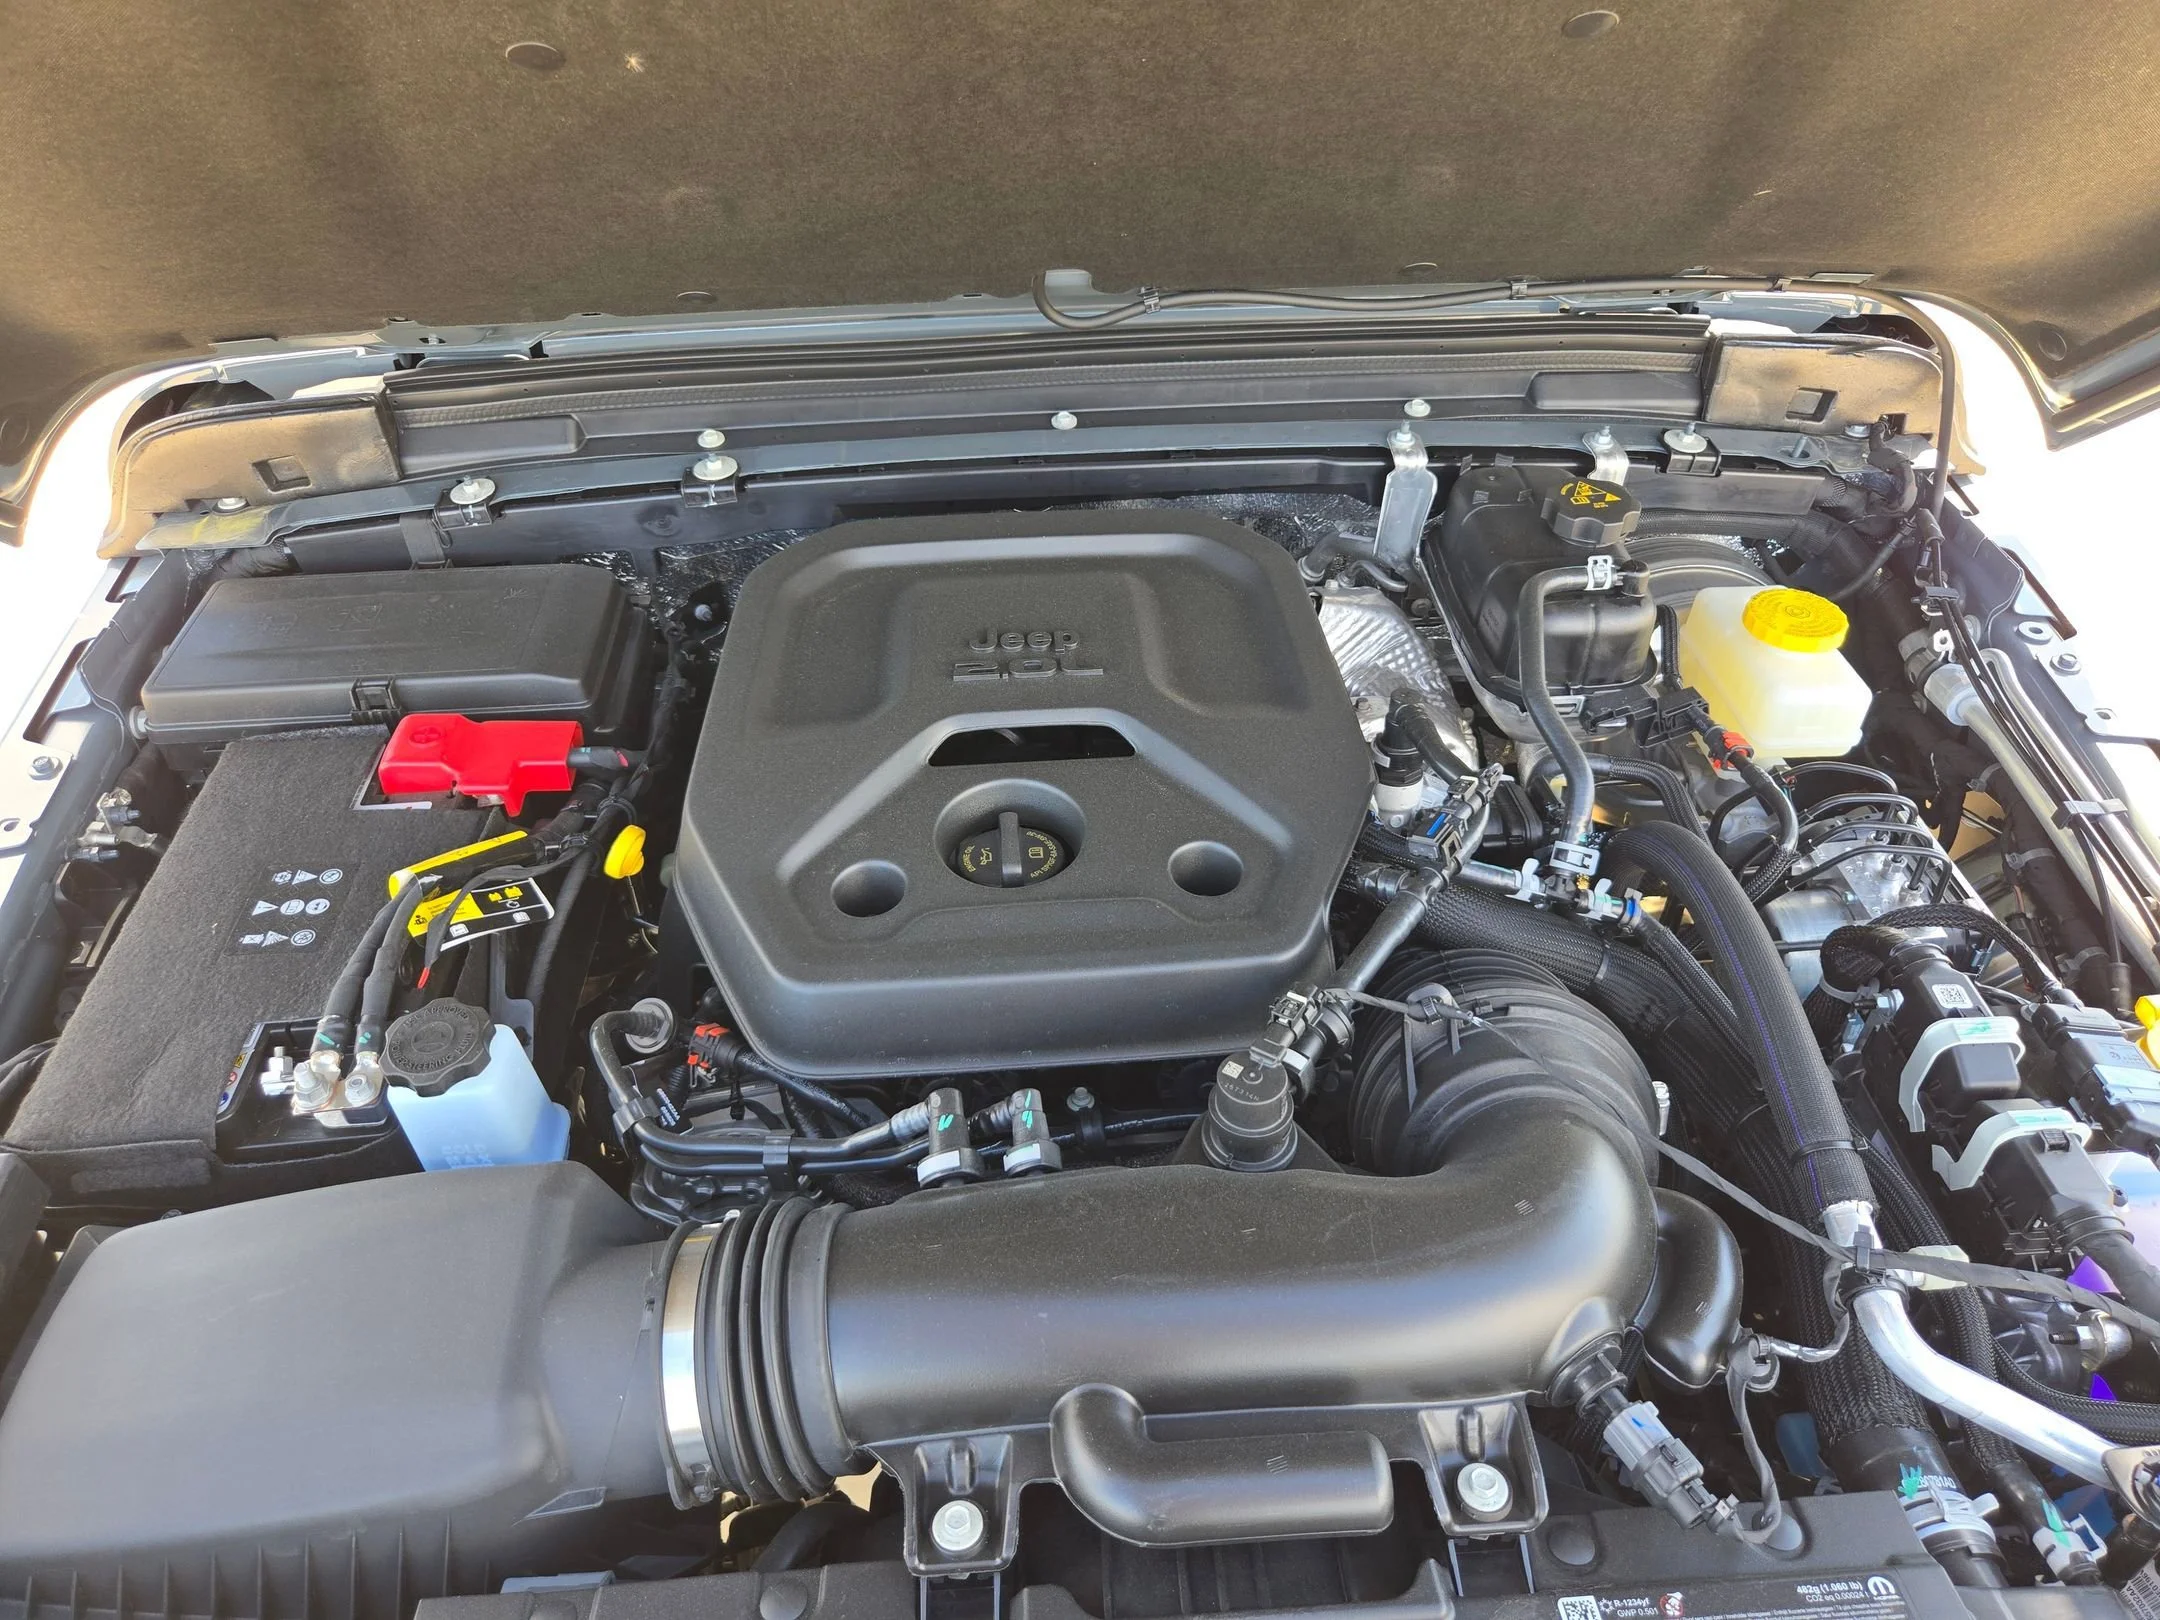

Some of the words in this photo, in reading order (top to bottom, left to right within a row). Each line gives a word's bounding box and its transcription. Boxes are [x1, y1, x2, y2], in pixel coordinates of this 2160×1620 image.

[969, 627, 1080, 655] Jeep
[953, 656, 1104, 682] 2.0L
[1613, 1597, 1650, 1607] R-1234yf
[1805, 1594, 1824, 1603] CO2
[1617, 1608, 1637, 1618] GWP
[1638, 1607, 1659, 1616] 0.501
